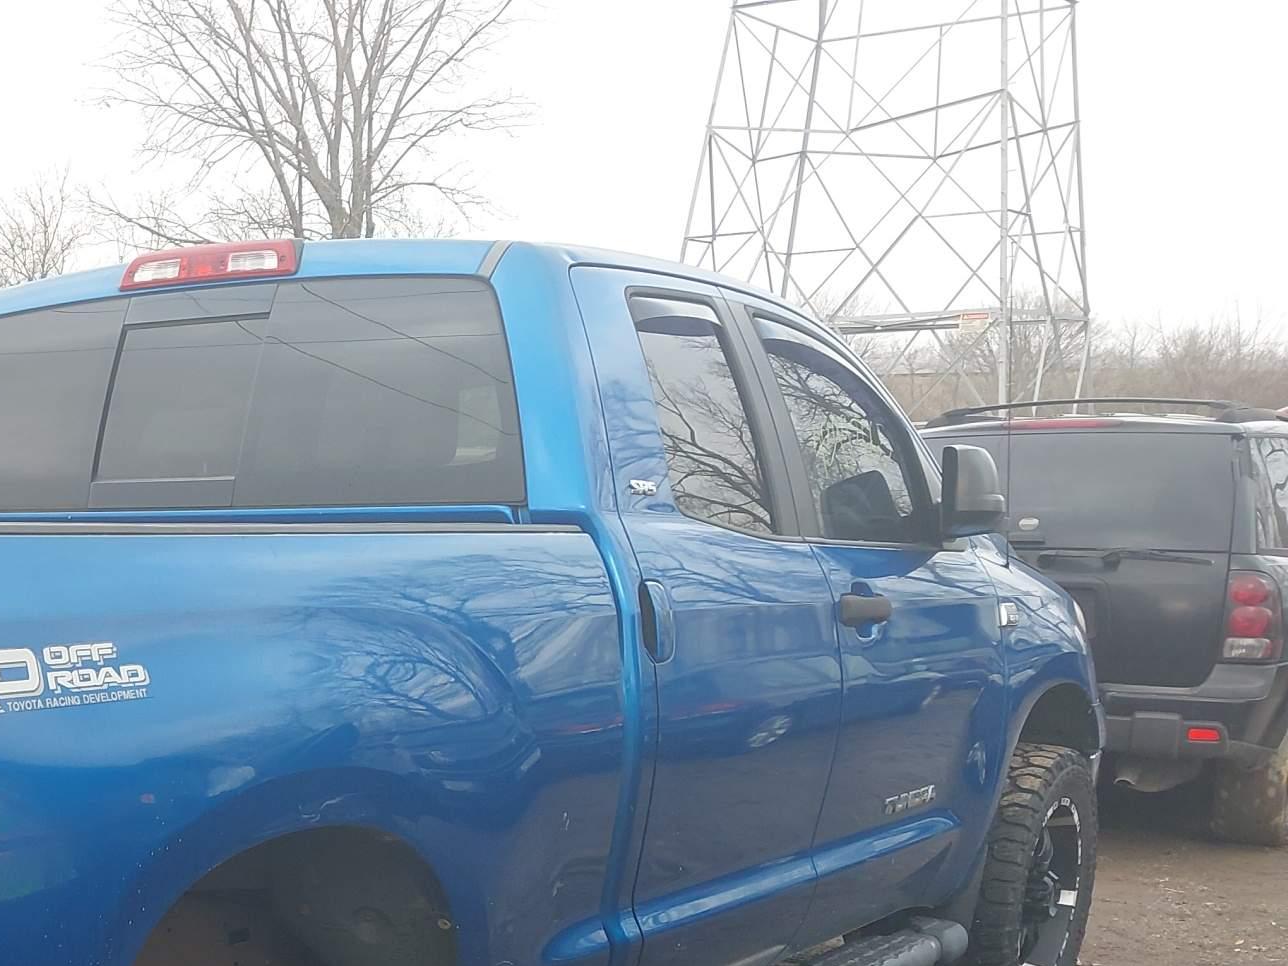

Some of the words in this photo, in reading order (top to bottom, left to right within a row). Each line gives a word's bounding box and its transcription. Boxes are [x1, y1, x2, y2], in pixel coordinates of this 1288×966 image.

[42, 642, 117, 668] OFF
[45, 664, 151, 693] ROAD
[6, 700, 44, 712] TOYOTA
[46, 694, 81, 709] RACING
[83, 687, 149, 704] DEVELOPMENT
